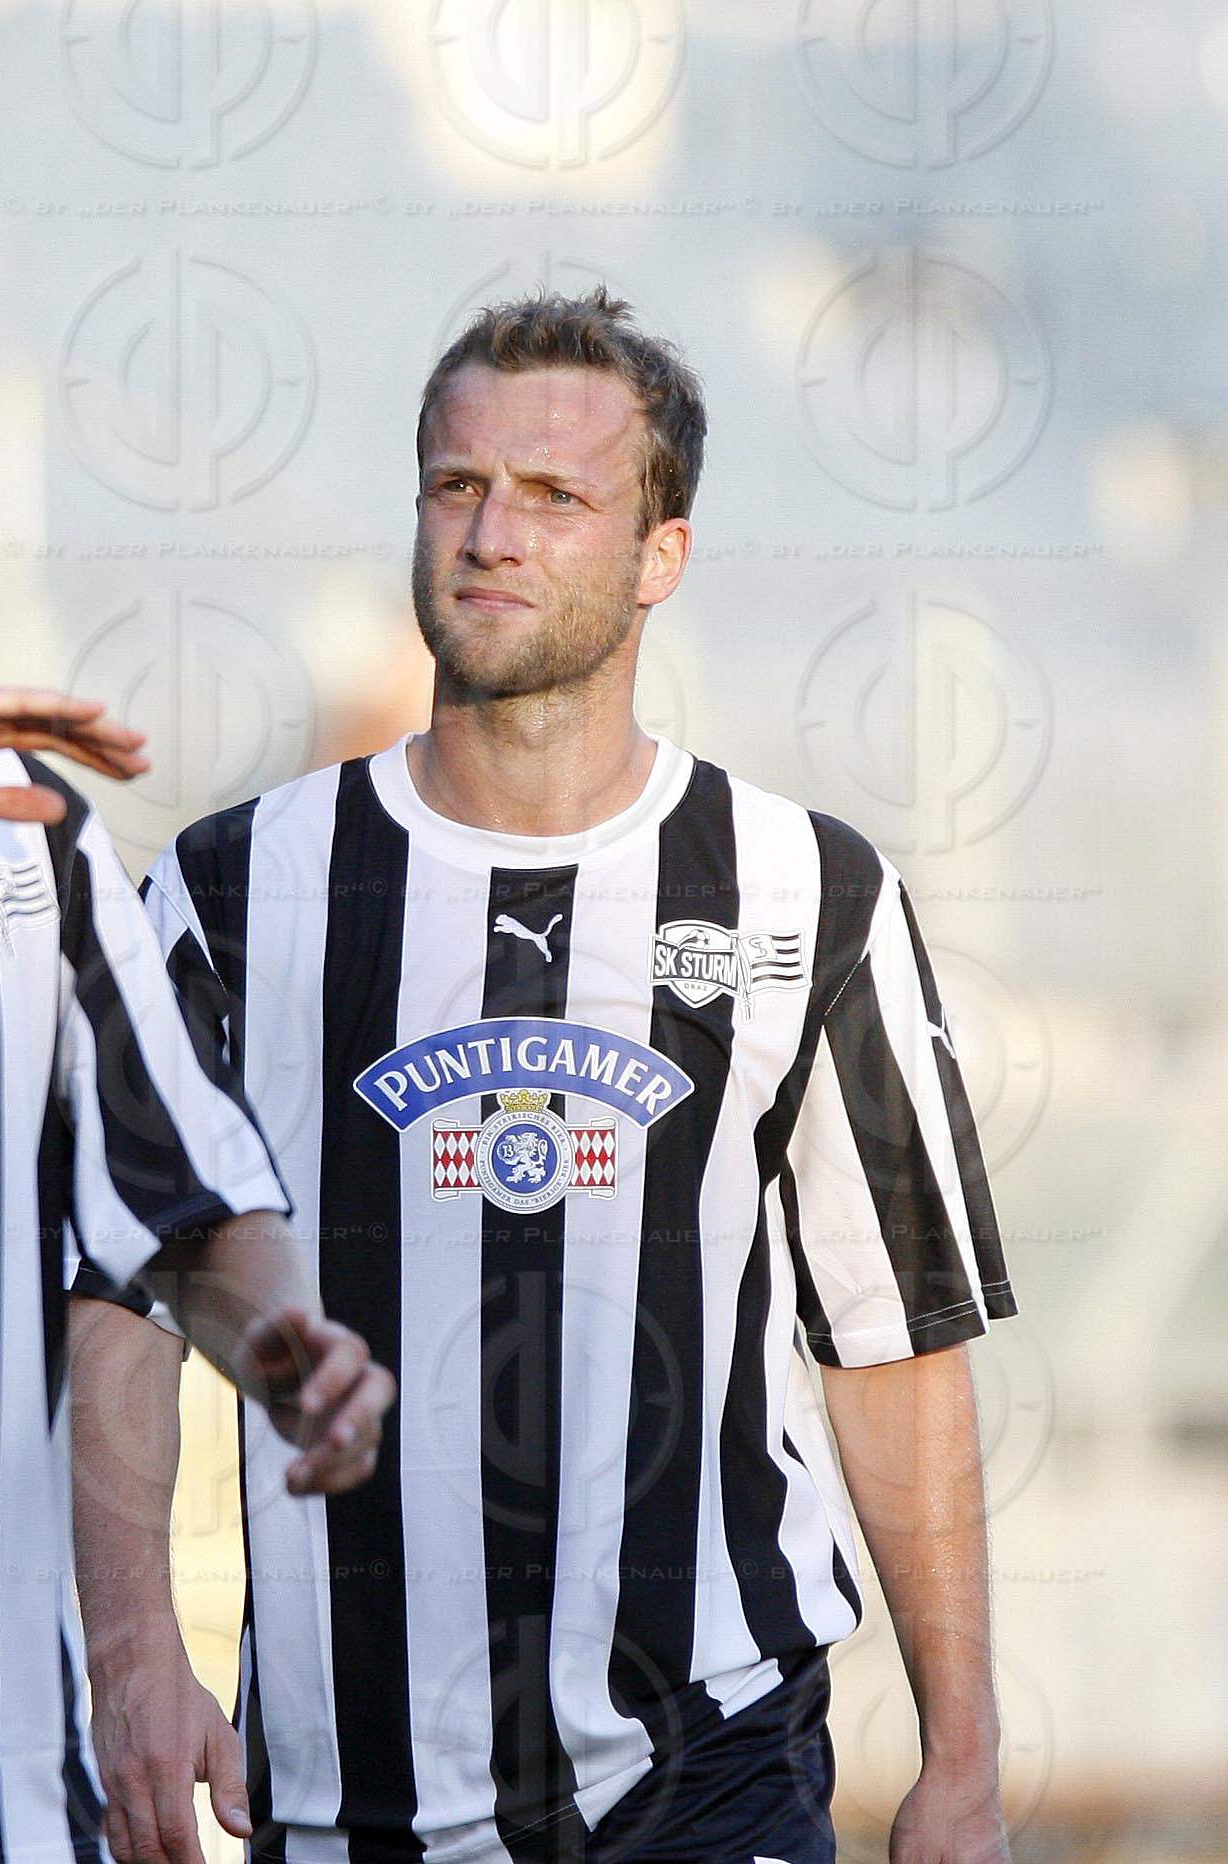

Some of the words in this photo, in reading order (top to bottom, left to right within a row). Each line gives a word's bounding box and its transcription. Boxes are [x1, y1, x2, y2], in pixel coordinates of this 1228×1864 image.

[654, 943, 678, 977] SK
[680, 951, 738, 988] STURM
[373, 1035, 671, 1114] PUNTIGAMER
